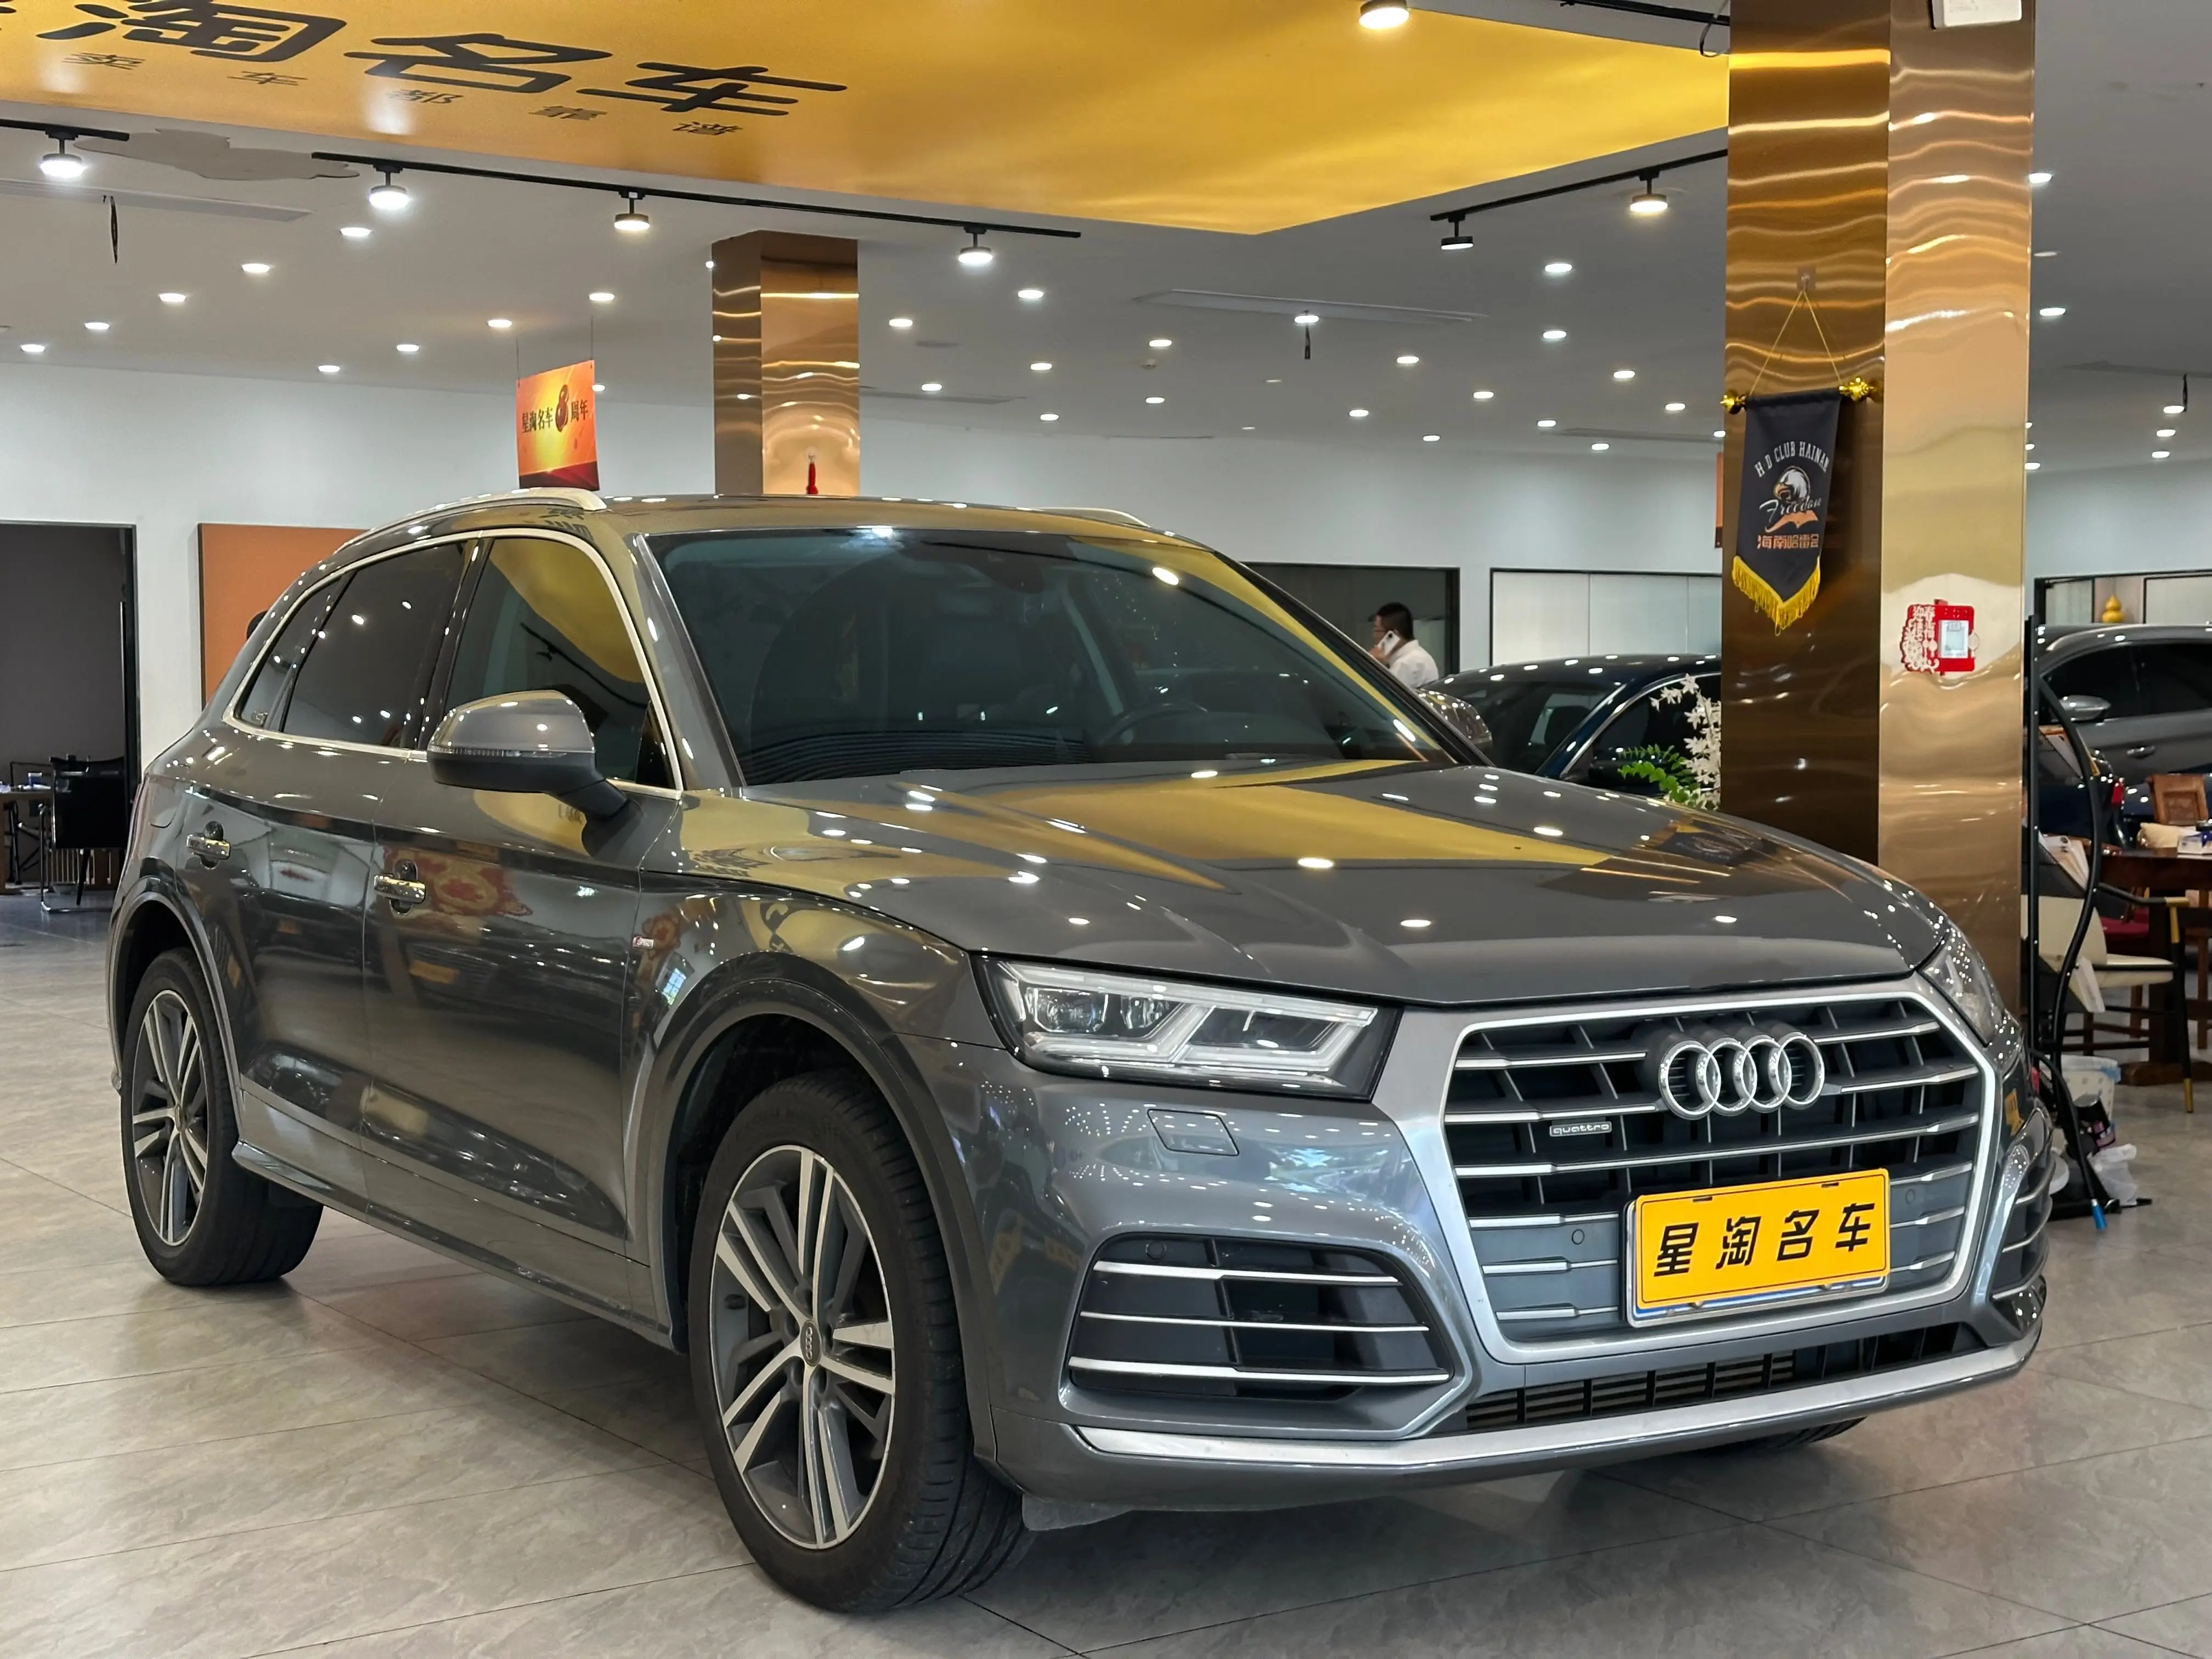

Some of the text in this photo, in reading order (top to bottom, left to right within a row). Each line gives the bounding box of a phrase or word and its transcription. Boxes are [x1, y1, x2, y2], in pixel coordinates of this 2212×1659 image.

[0, 0, 848, 116] 淘名车
[1774, 441, 1796, 462] CLUB
[1799, 441, 1830, 473] HAINAN
[1553, 1124, 1610, 1135] quattro
[1654, 1203, 1875, 1277] 星淘名车
